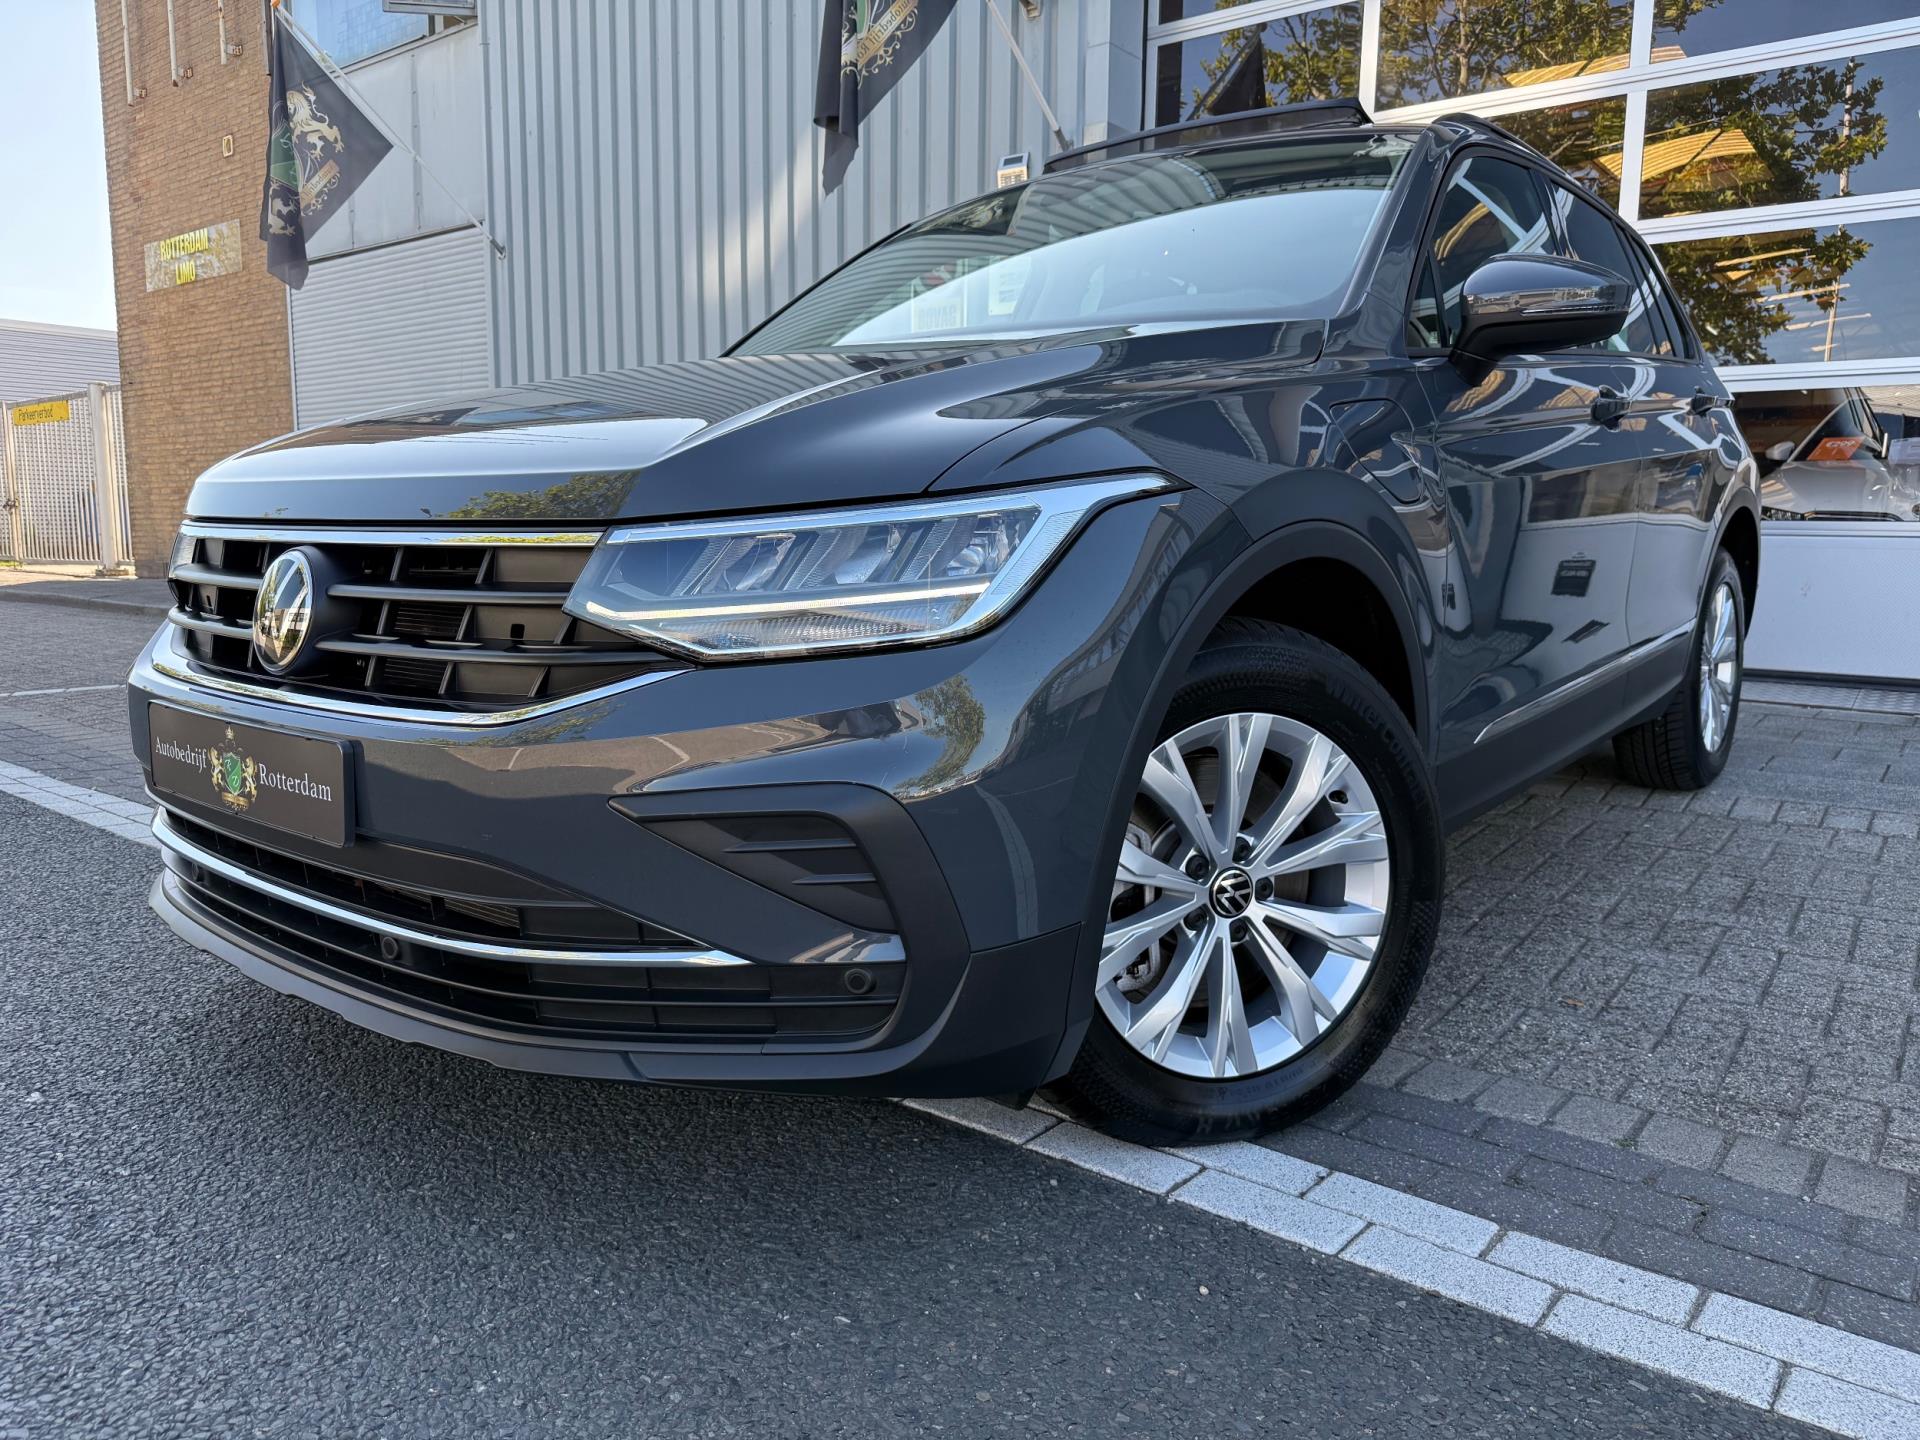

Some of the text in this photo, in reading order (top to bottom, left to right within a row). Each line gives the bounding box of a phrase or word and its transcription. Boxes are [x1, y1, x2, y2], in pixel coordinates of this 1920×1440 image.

[160, 228, 209, 260] ROTTERDAM
[175, 259, 196, 286] LIMO
[18, 408, 54, 421] Parkeerverbod
[155, 736, 332, 801] Autobedrijf Rotterdam
